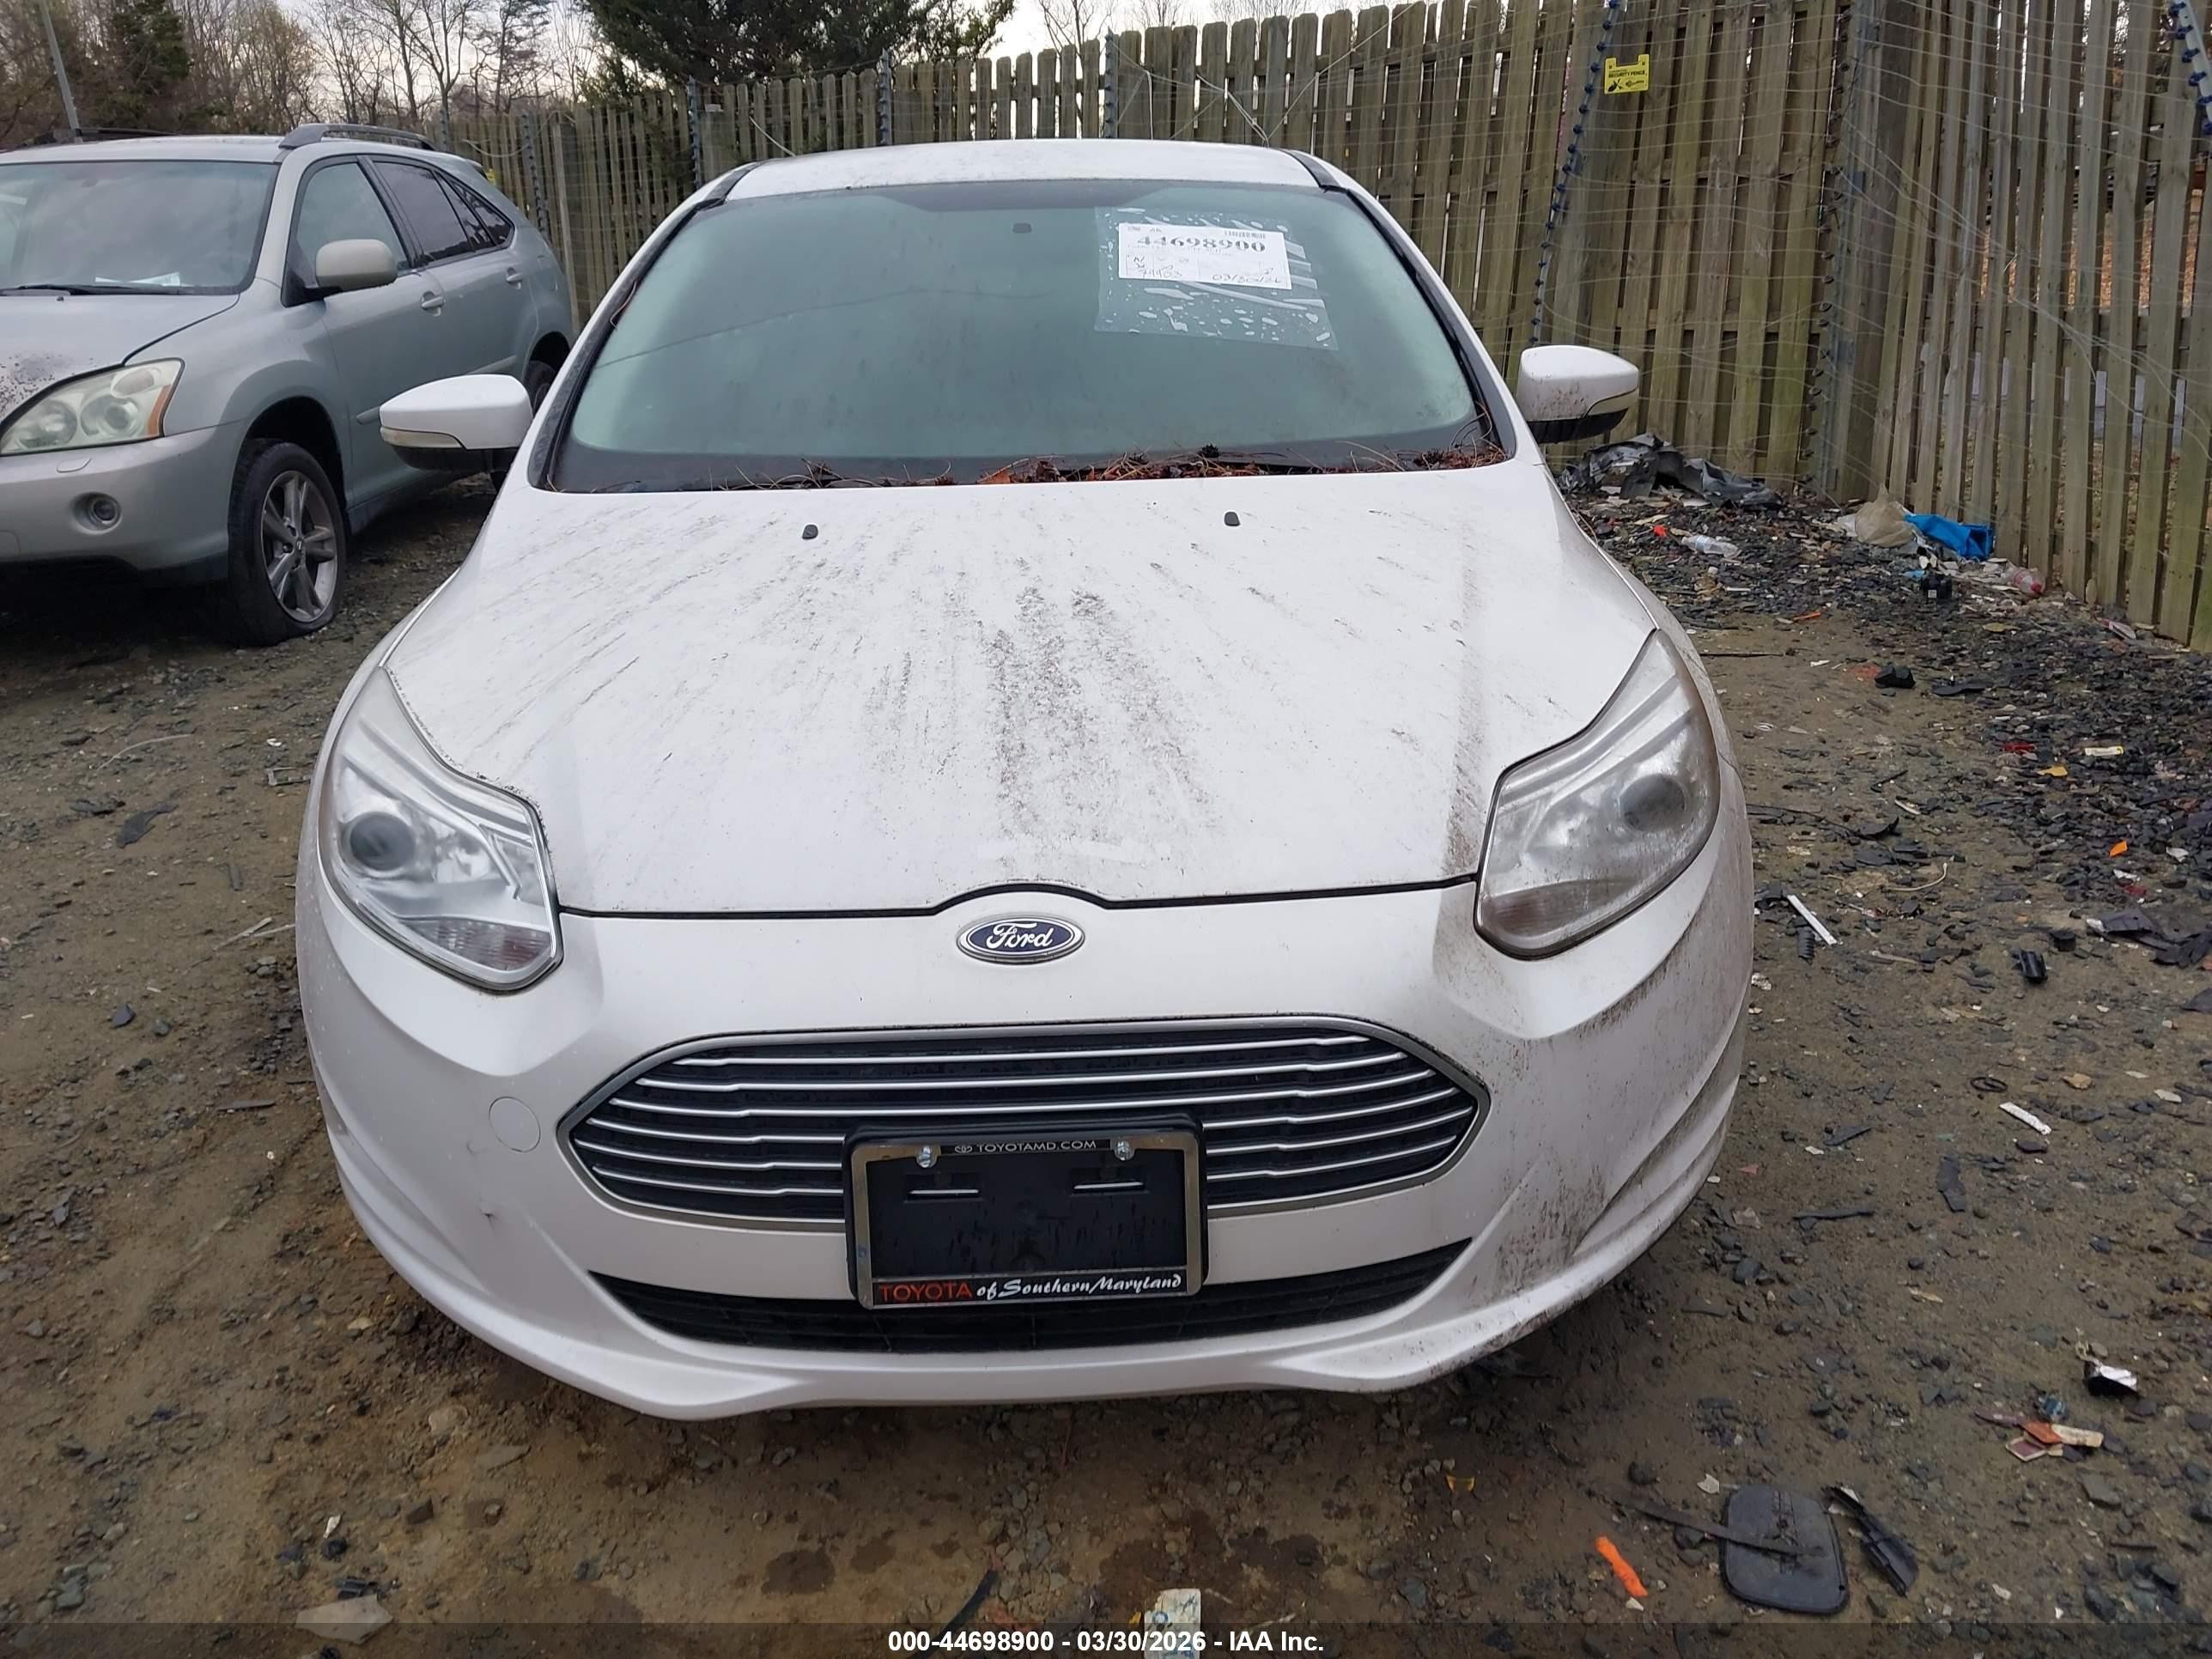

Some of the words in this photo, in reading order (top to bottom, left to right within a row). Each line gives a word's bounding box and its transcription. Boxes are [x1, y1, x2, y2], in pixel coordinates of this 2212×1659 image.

[1137, 235, 1266, 252] 44698900
[986, 922, 1054, 949] Ford
[977, 1139, 1097, 1153] TOYOTAMD.COM
[880, 1282, 972, 1304] TOYOTA
[975, 1283, 999, 1300] of
